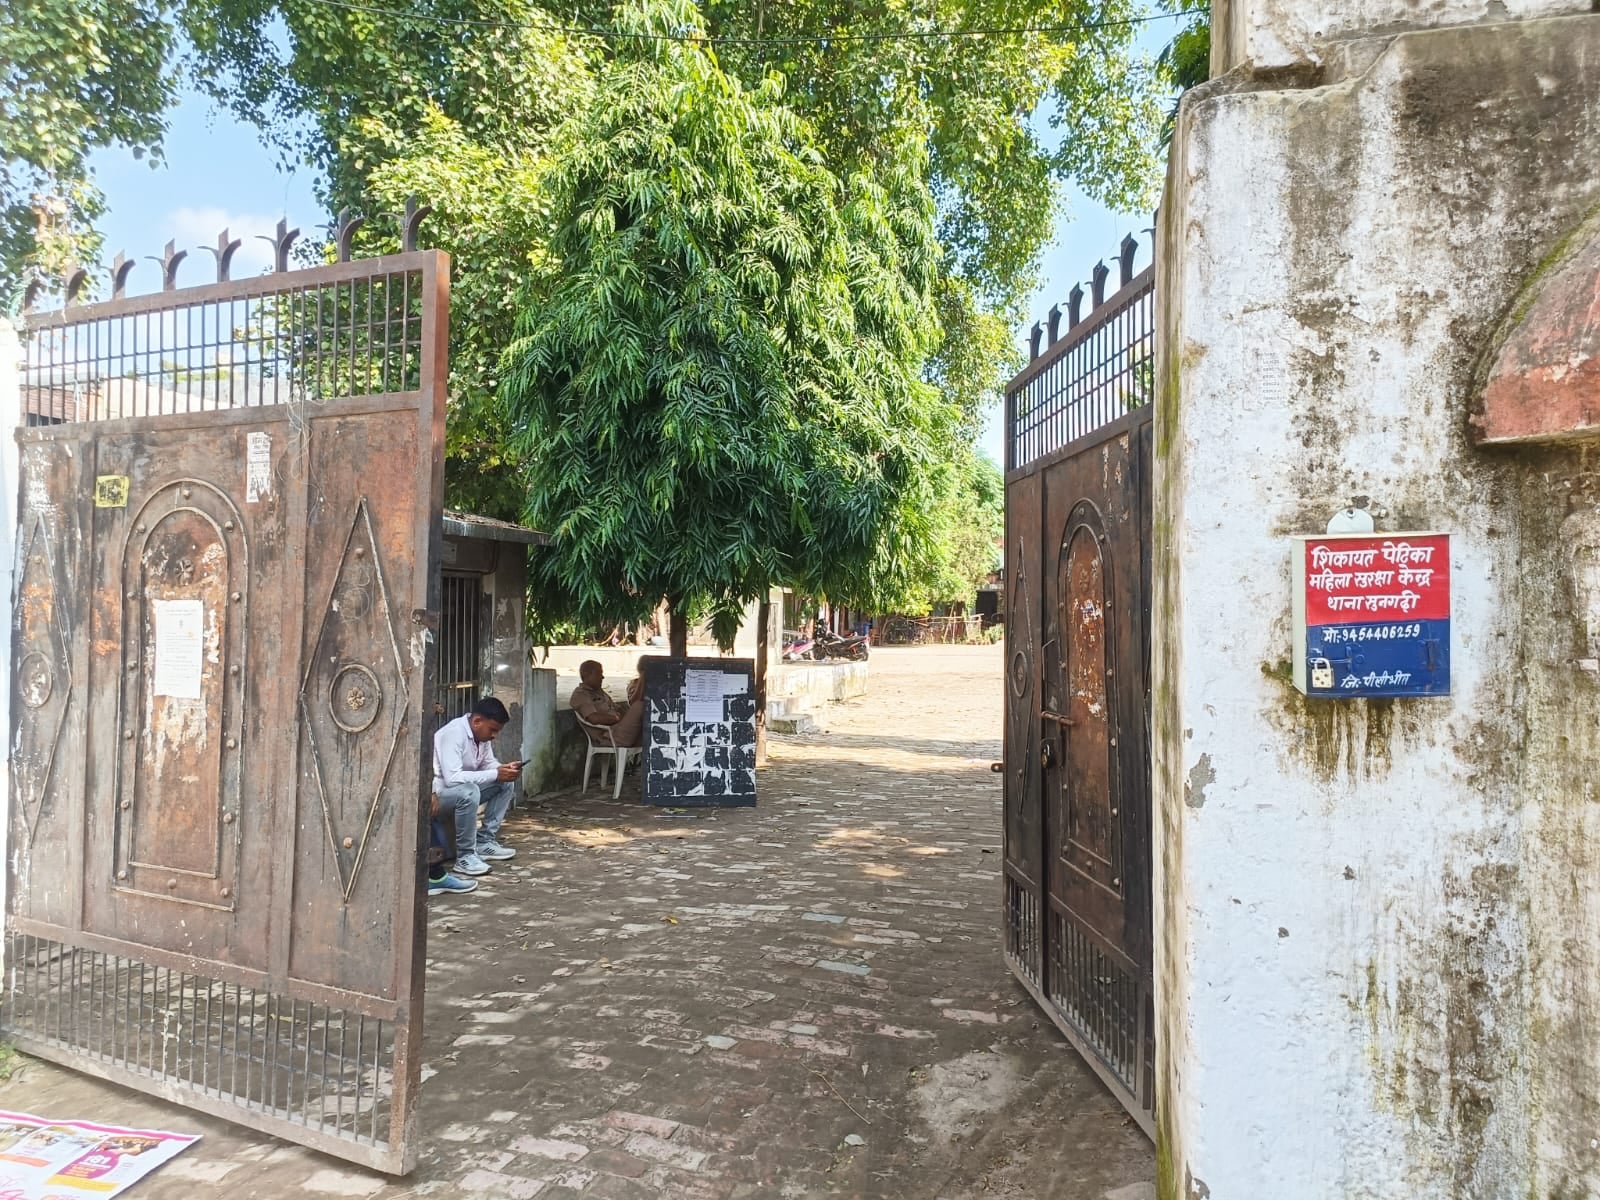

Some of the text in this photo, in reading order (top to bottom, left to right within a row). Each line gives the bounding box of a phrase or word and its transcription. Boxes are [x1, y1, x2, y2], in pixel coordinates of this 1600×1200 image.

[1311, 541, 1435, 569] शिकायत पेटिका
[1309, 563, 1434, 592] महिला सुरक्षा केन्द्र
[1327, 596, 1365, 611] थाना
